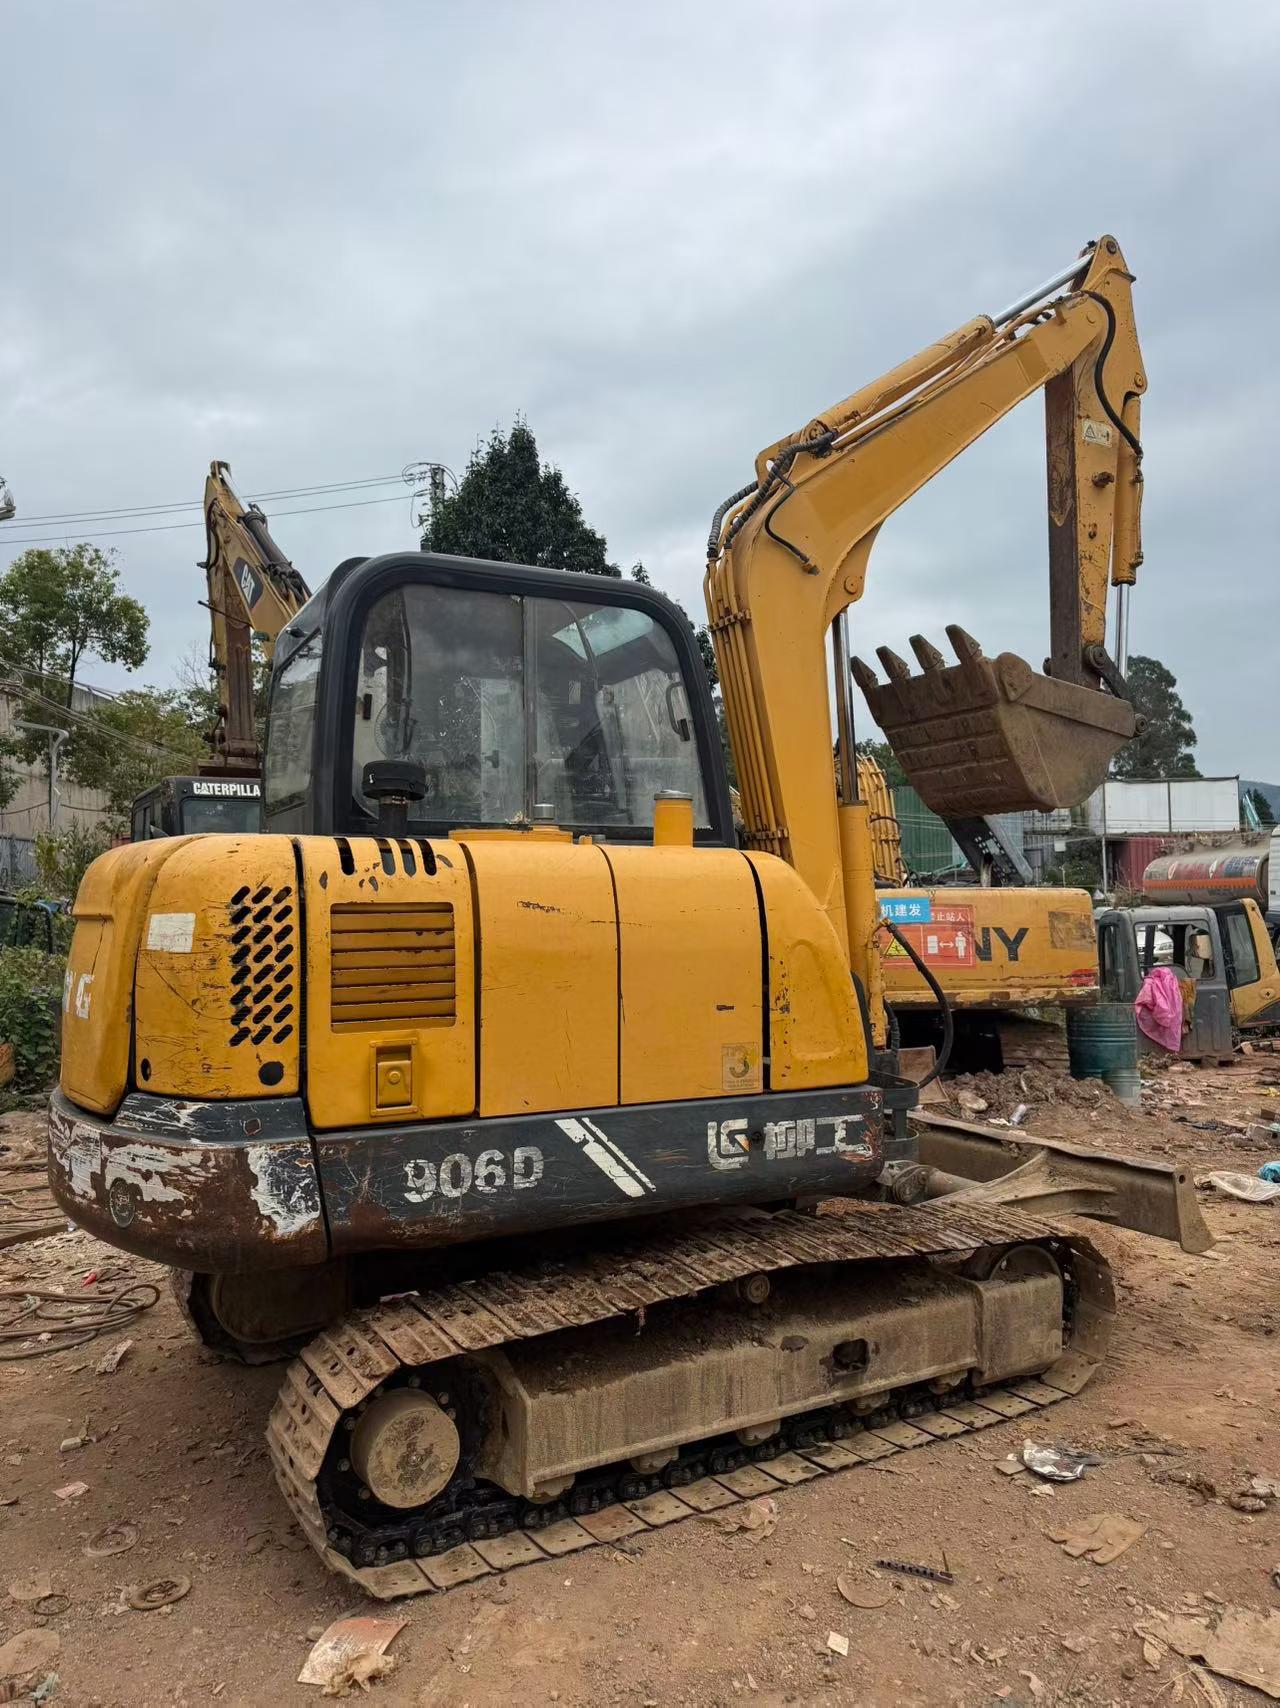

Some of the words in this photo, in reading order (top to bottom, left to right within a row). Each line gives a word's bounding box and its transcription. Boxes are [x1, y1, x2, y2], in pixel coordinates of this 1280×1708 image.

[931, 911, 966, 922] 止站人
[404, 1146, 544, 1203] 906D
